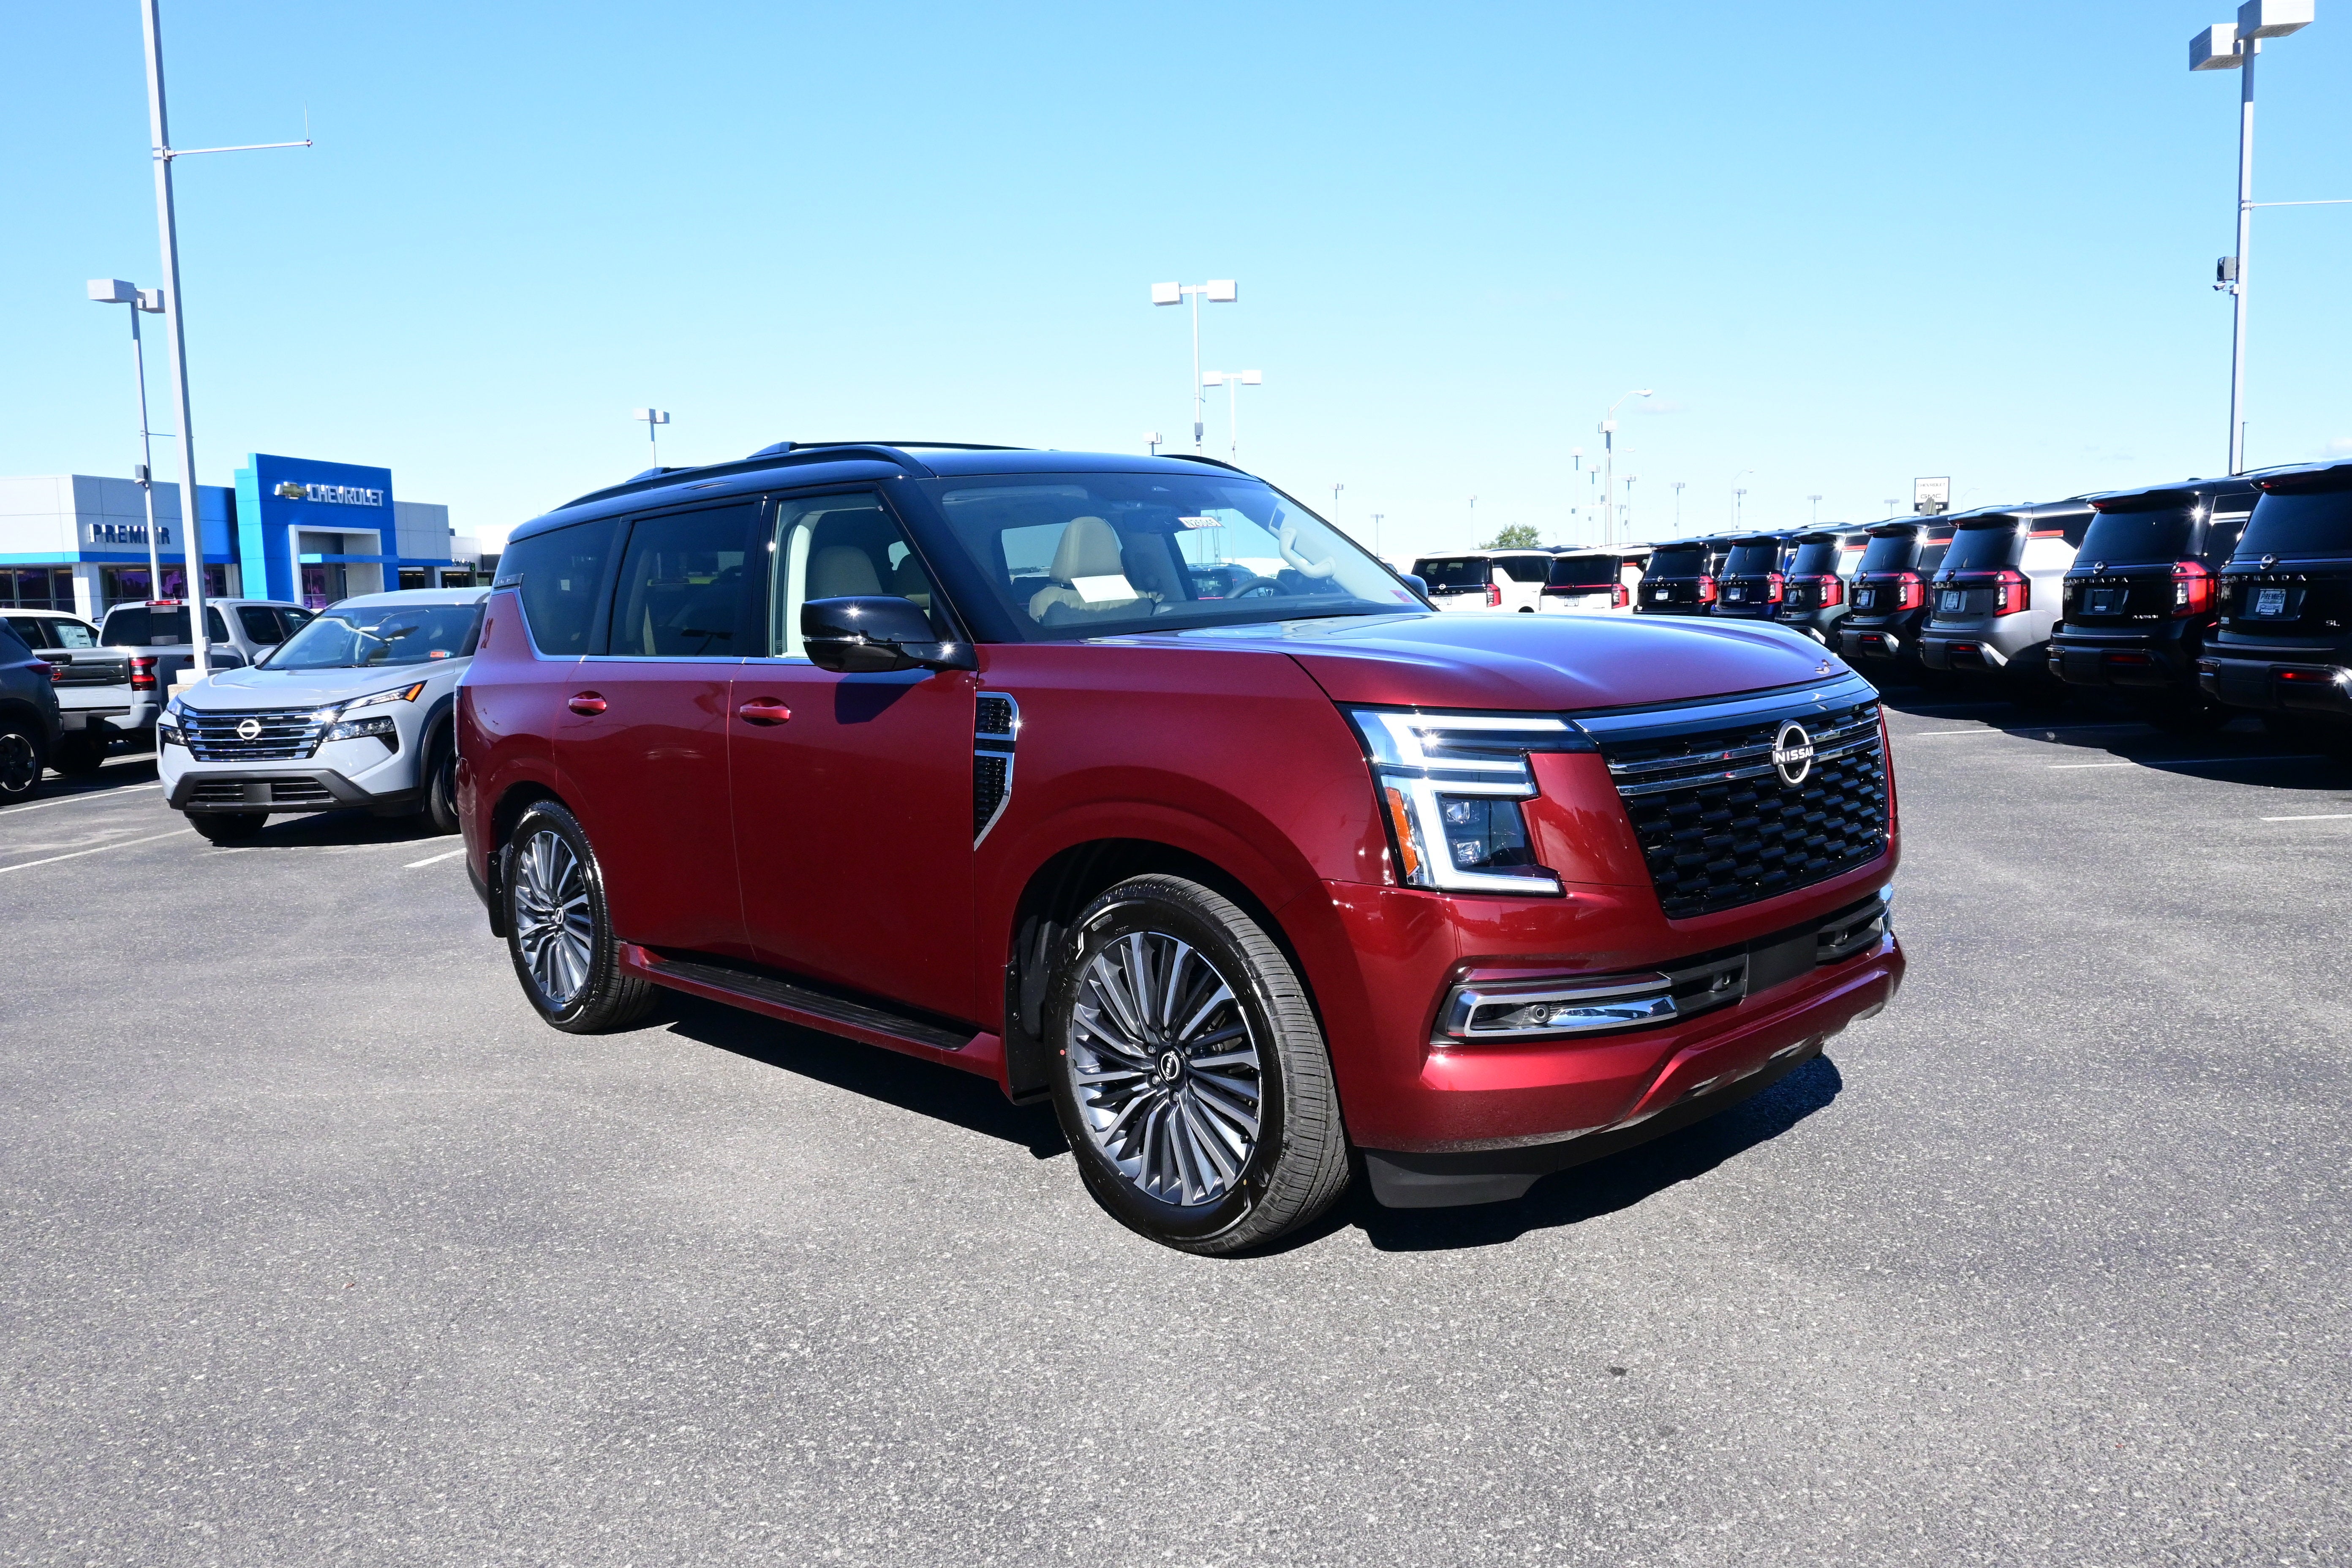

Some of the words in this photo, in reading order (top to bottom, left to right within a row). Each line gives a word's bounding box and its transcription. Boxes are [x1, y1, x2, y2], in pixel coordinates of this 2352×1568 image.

[305, 484, 384, 506] CHEVROLET
[89, 523, 170, 544] PREMIR
[1775, 746, 1814, 763] NISSAN
[1165, 1050, 1176, 1081] NISSAN
